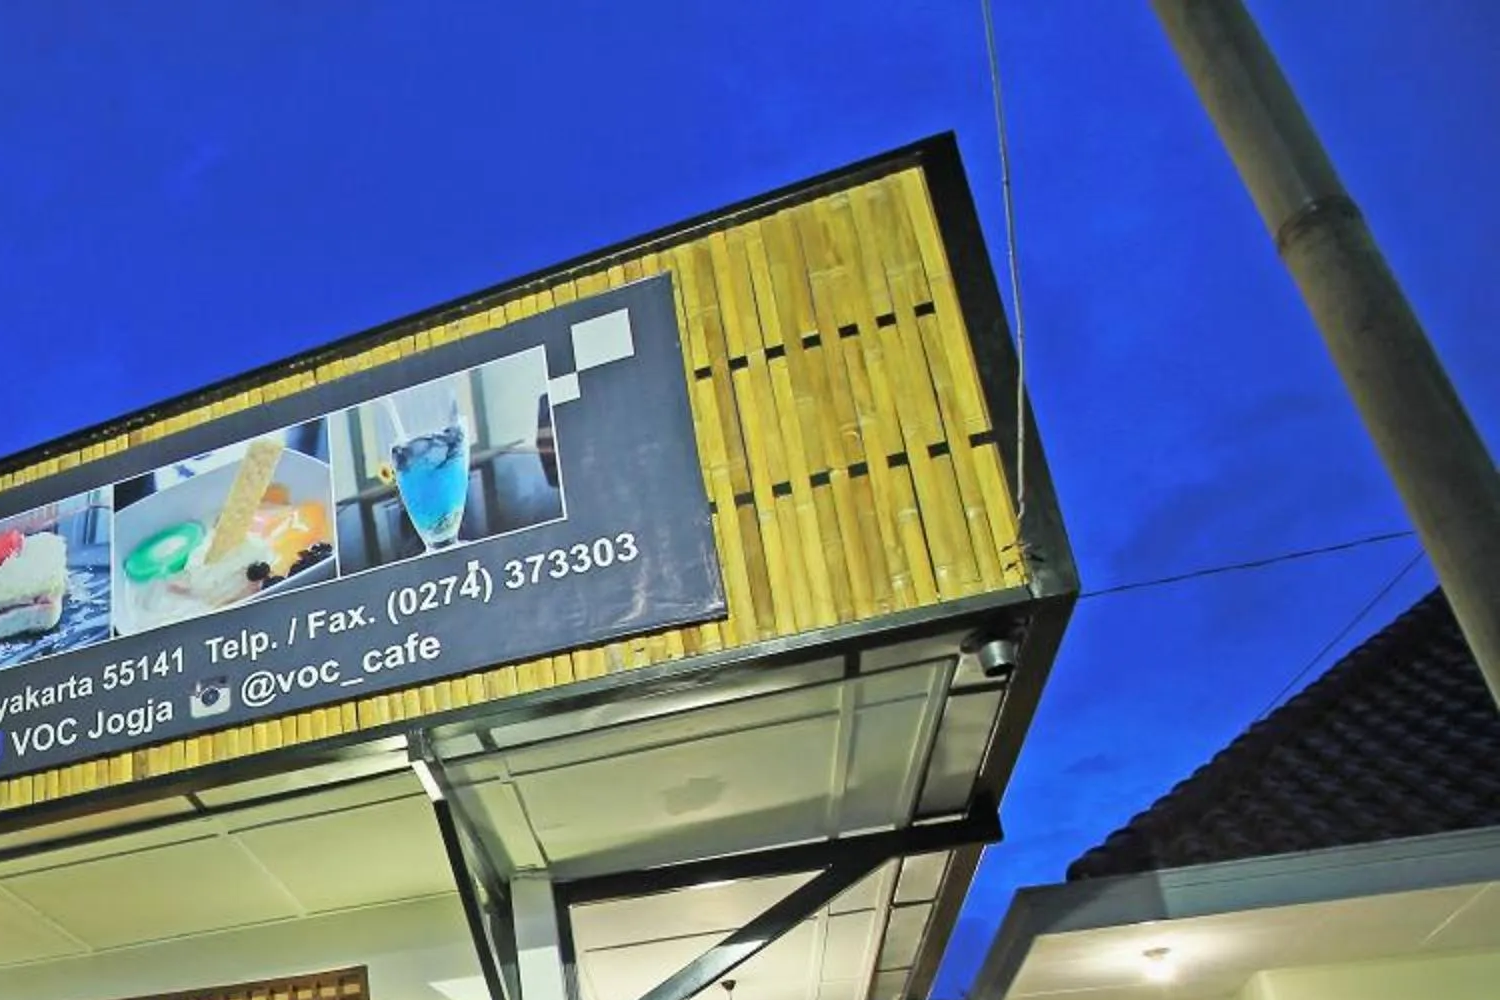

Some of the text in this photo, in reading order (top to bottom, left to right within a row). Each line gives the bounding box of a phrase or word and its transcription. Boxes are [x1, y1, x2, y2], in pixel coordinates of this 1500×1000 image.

[102, 647, 185, 690] 55141
[205, 629, 277, 664] Telp.
[307, 603, 375, 639] Fax.
[387, 562, 494, 624] (0274)
[504, 532, 640, 590] 373303
[10, 718, 77, 756] VOC
[88, 699, 173, 739] Jogja
[241, 632, 441, 707] @voc_cafe
